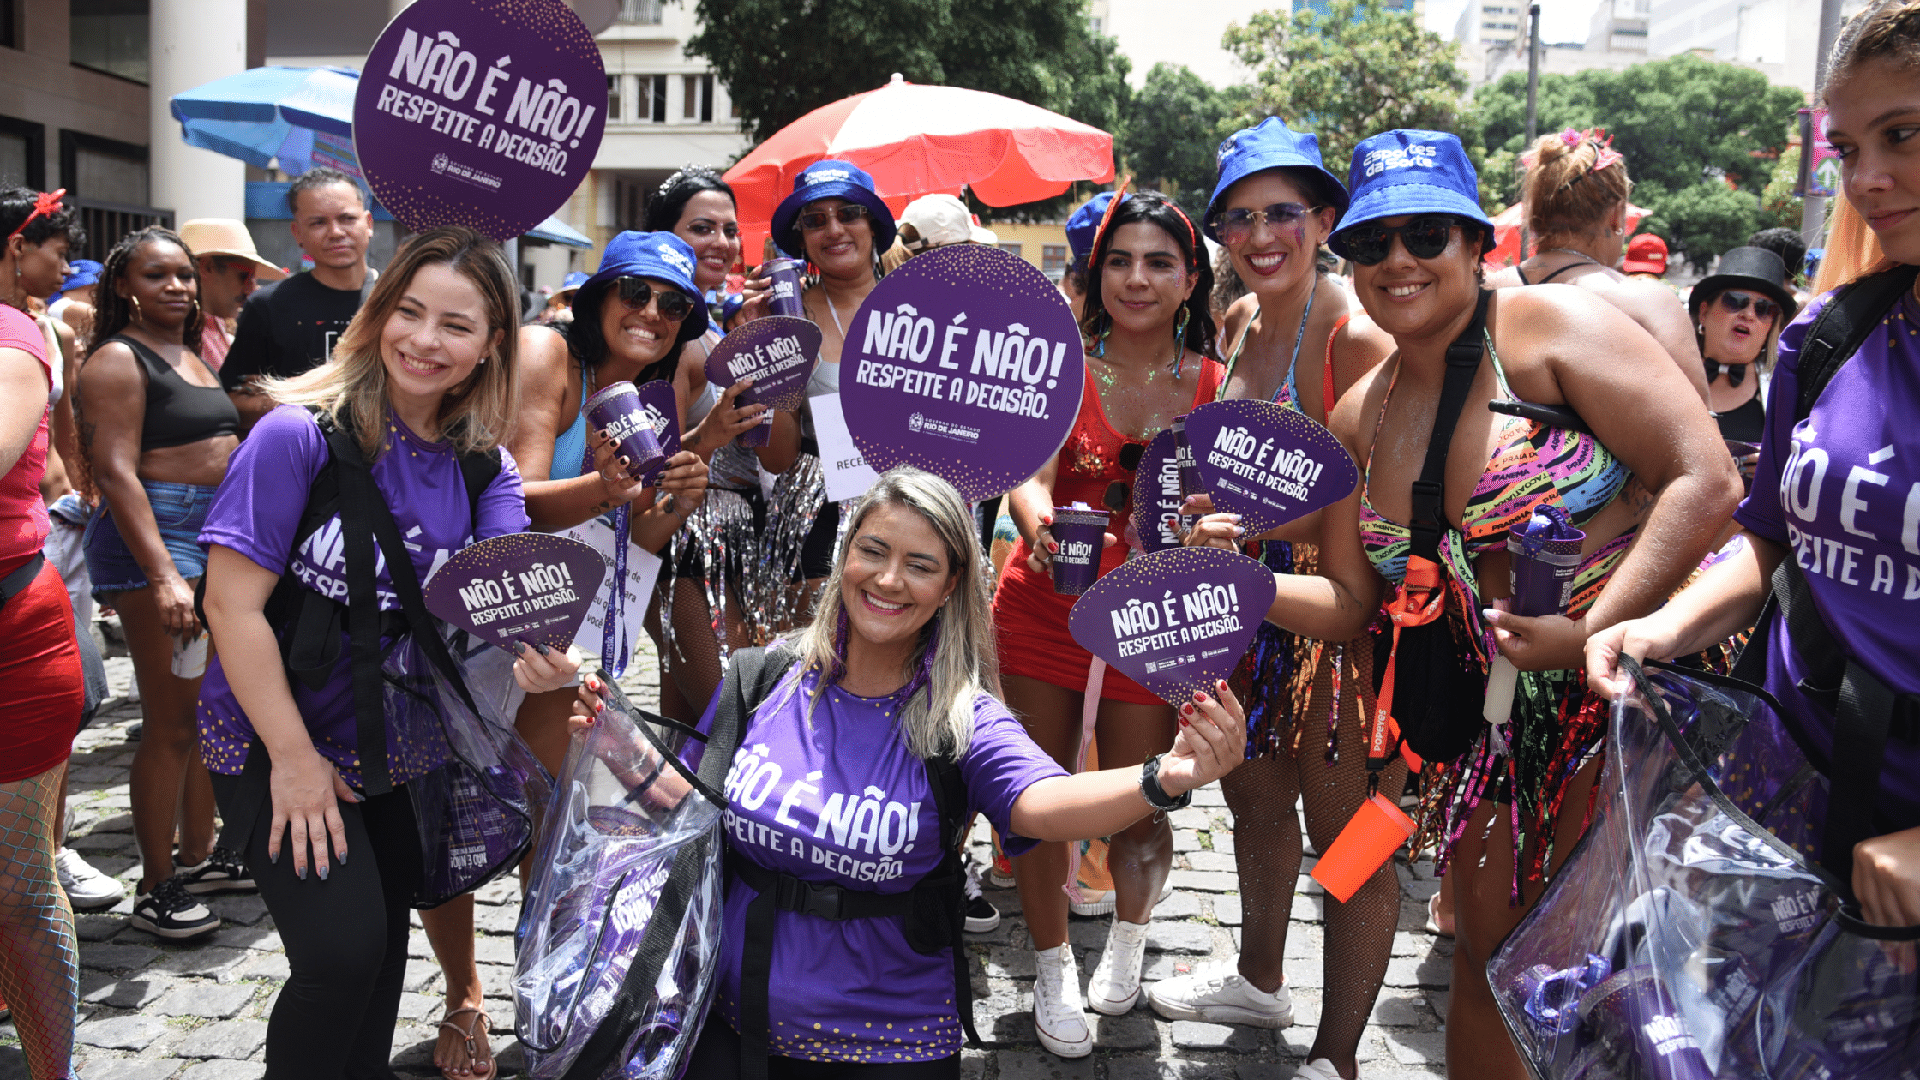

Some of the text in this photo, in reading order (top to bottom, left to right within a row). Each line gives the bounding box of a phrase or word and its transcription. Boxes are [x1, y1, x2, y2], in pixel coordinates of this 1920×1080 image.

[389, 28, 596, 149] NÃO É NÃO!
[377, 84, 481, 143] RESPEITE
[478, 124, 496, 149] A
[495, 129, 567, 177] DECISÃO.
[1363, 143, 1436, 167] Esportes
[1365, 155, 1432, 178] da Sorte
[726, 335, 802, 377] NÃO É NÃO!
[862, 303, 1067, 389] NÃO É NÃO!
[769, 364, 777, 375] A
[855, 359, 1049, 420] RESPEITE A DECISÃO.
[621, 414, 631, 428] É
[924, 422, 937, 430] RIO
[938, 424, 948, 432] DE
[948, 428, 979, 439] JANEIRO
[1207, 450, 1258, 480] RESPEITE
[1256, 471, 1266, 484] A
[1265, 474, 1308, 502] DECISÃO.
[1214, 426, 1323, 487] NÃO É NÃO!
[1157, 499, 1180, 509] É
[1839, 443, 1895, 541] É
[1060, 539, 1092, 557] É NÃO!
[459, 562, 574, 611] NÃO É NÃO!
[1870, 554, 1894, 595] A
[470, 601, 523, 626] RESPEITE
[525, 602, 533, 613] A
[533, 588, 579, 610] DECISÃO.
[1110, 583, 1240, 639] NÃO É NÃO!
[1117, 630, 1179, 658] RESPEITE
[1180, 627, 1191, 642] A
[1191, 614, 1244, 641] DECISÃO.
[774, 770, 823, 829] É
[813, 785, 922, 855] NÃO!
[791, 837, 804, 859] A
